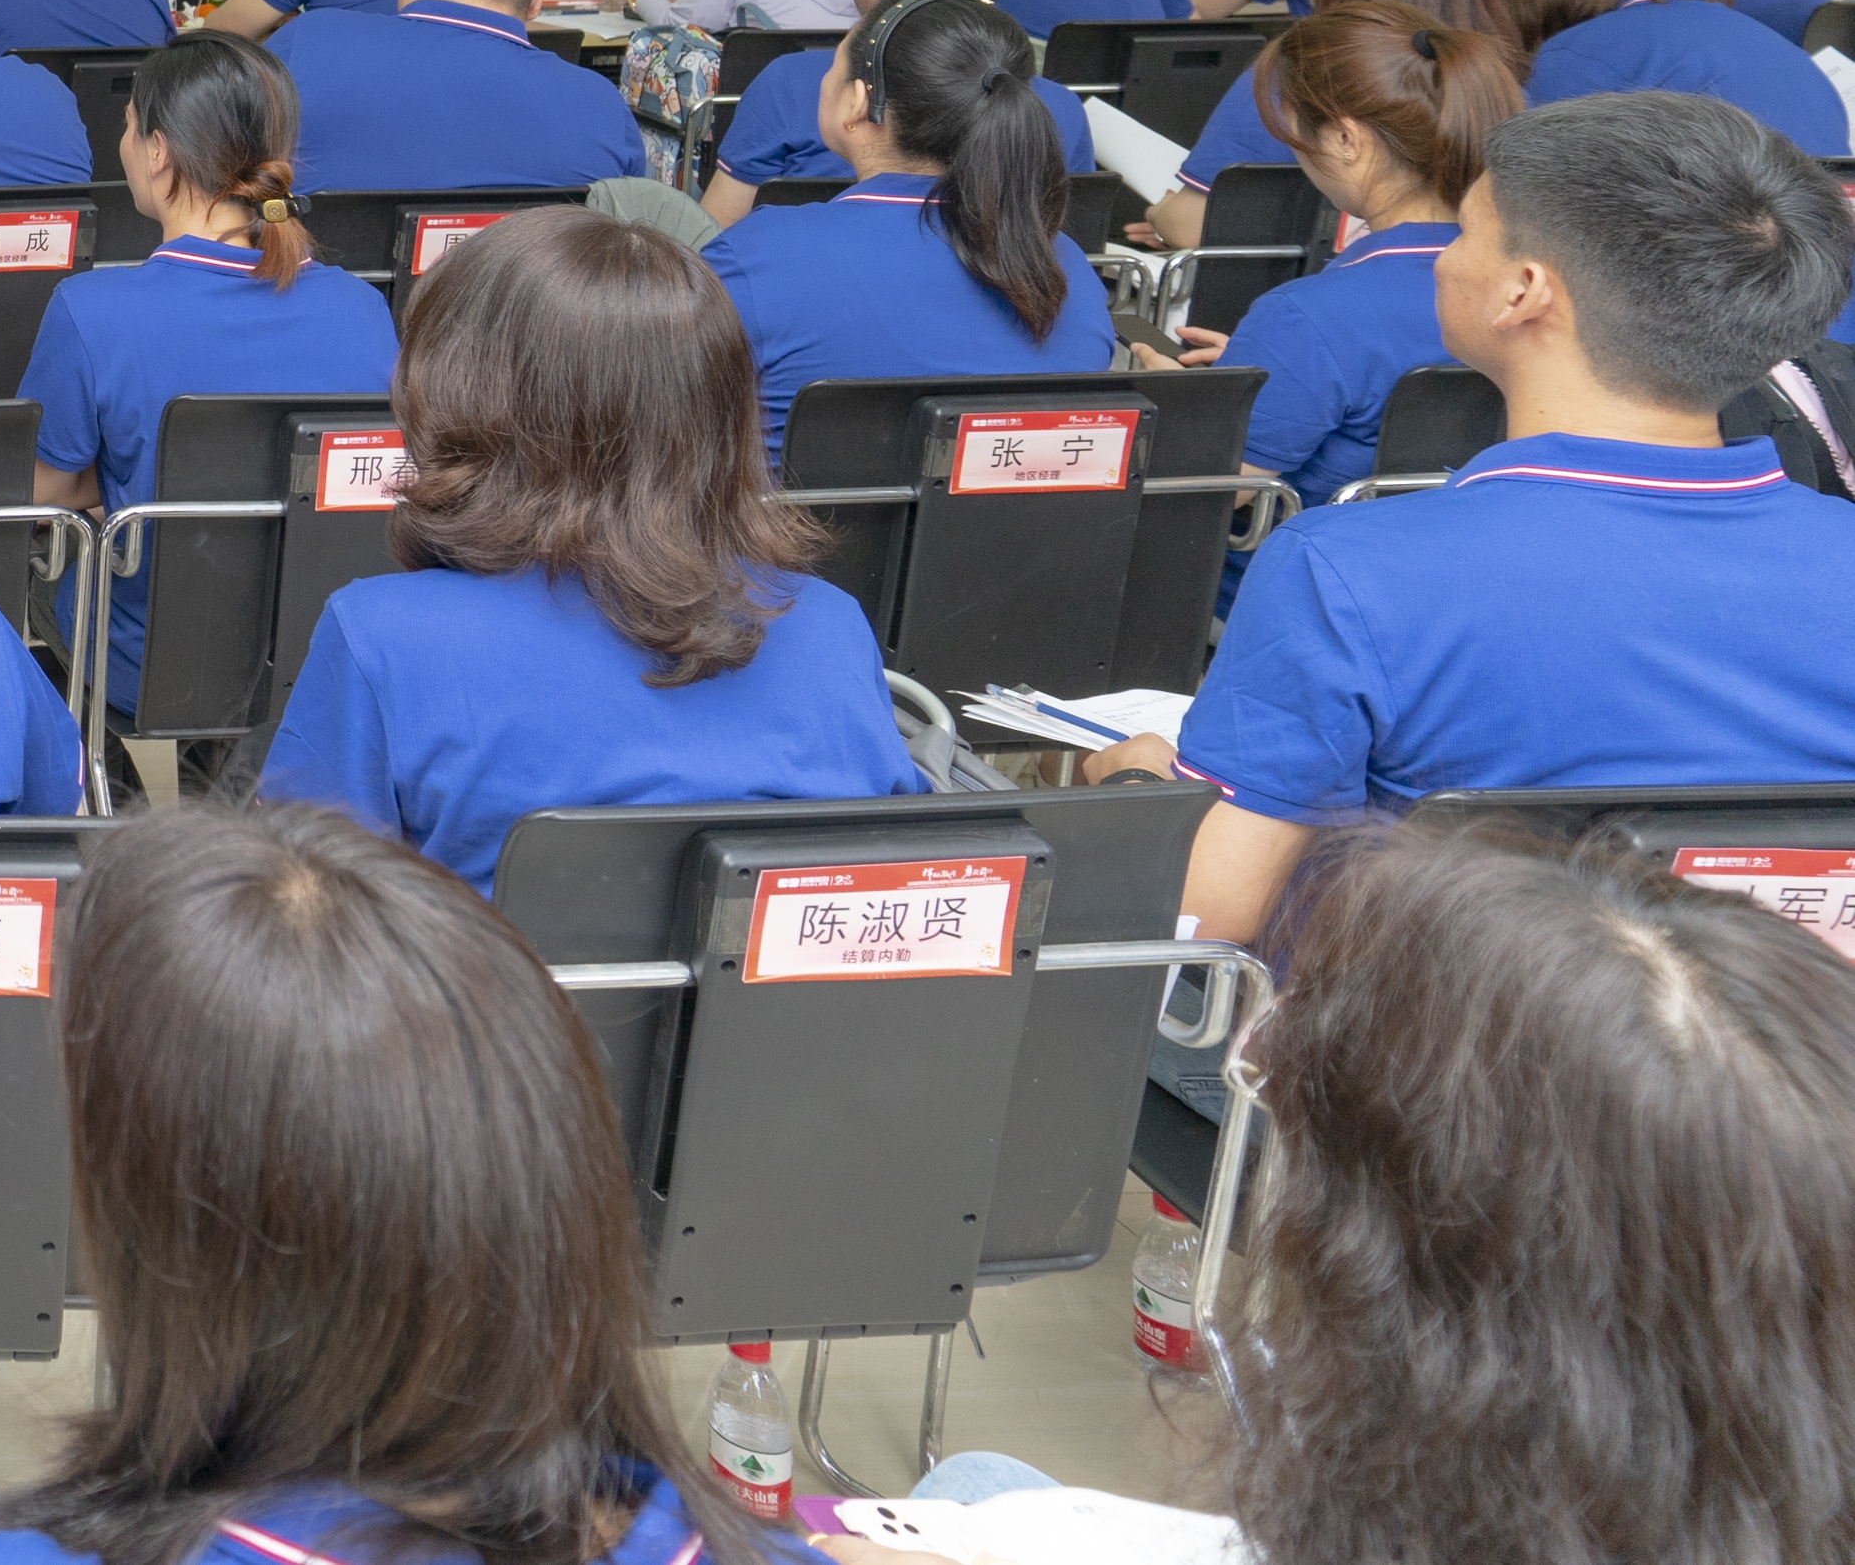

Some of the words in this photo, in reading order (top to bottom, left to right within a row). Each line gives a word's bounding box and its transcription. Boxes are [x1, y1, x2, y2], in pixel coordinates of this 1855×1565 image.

[990, 434, 1095, 469] 张宁
[1014, 468, 1061, 482] 地区经理
[797, 896, 969, 947] 陈淑贤
[840, 945, 912, 965] 结算内勤
